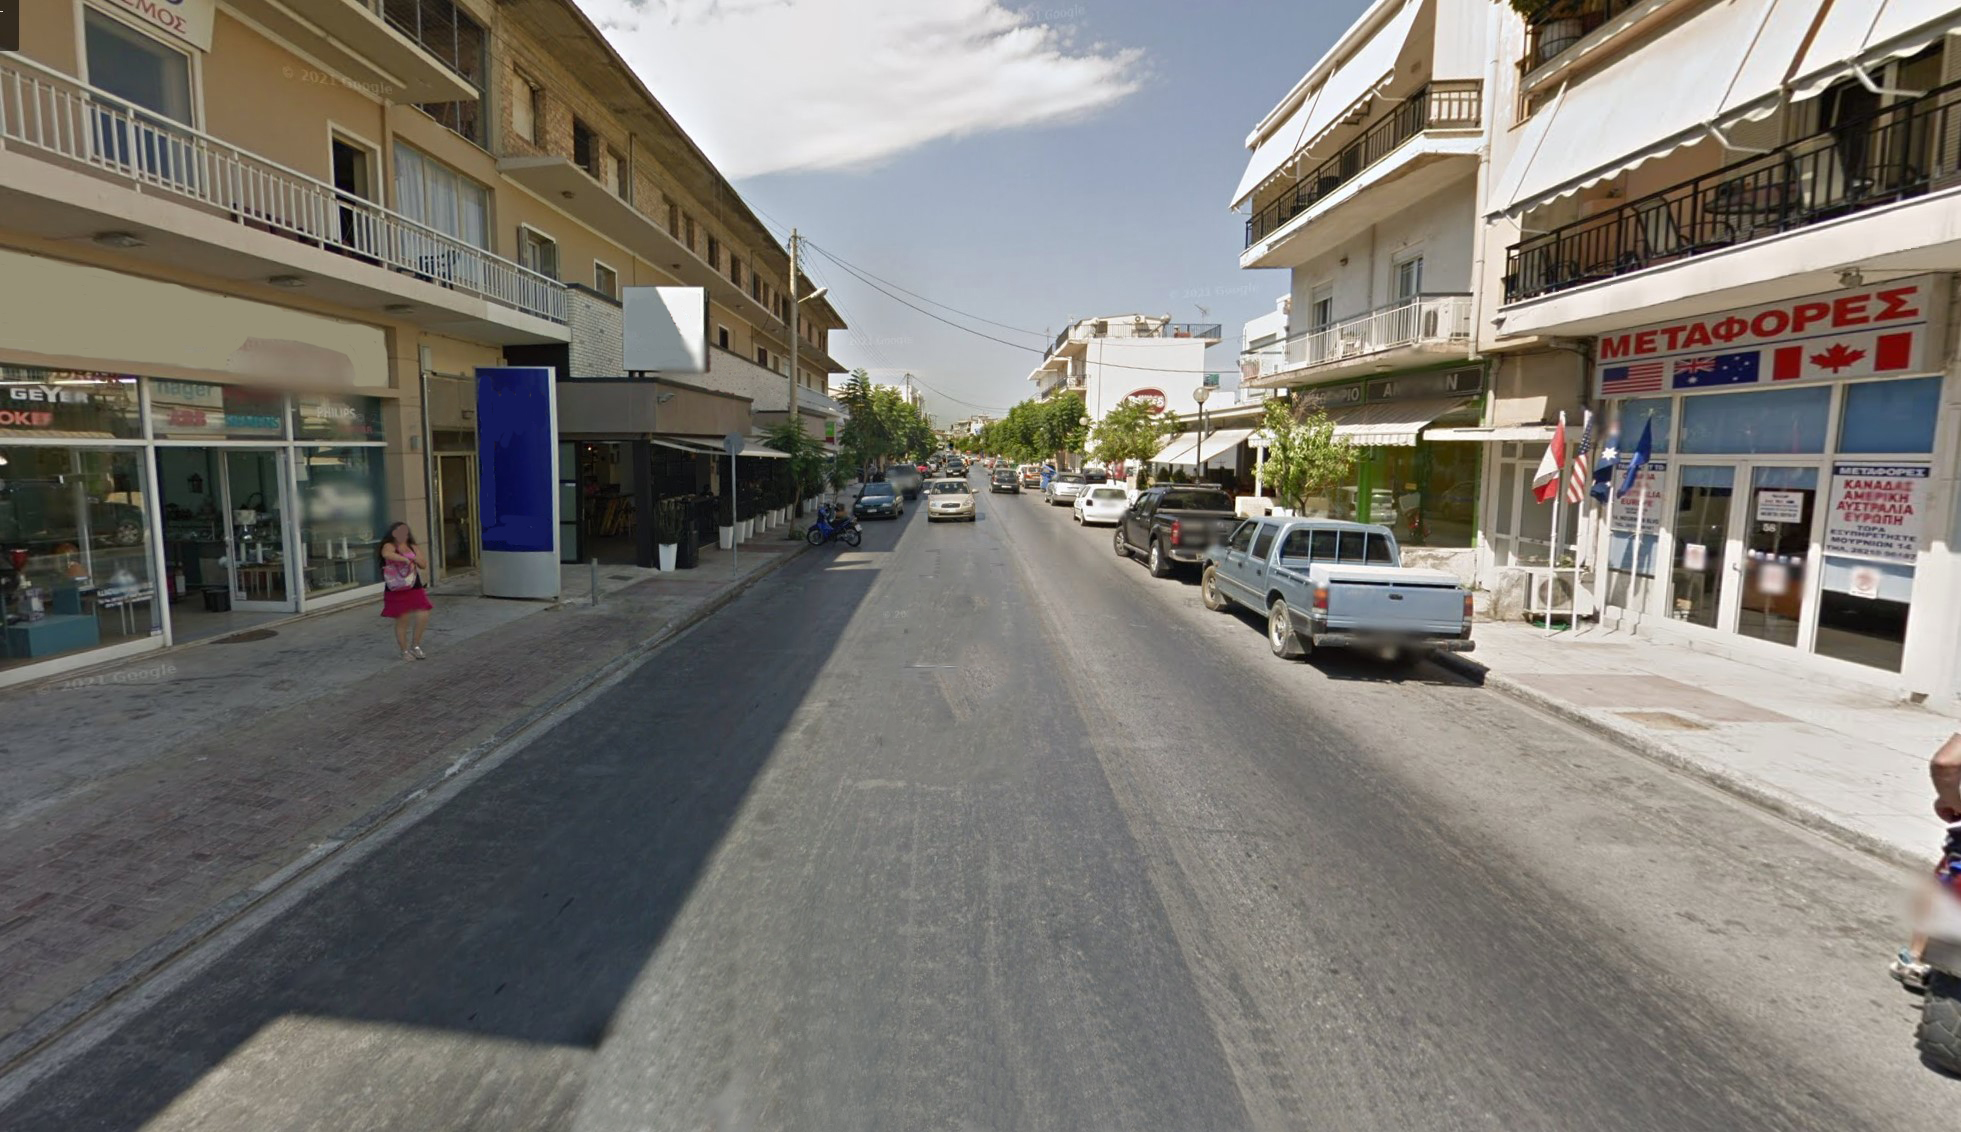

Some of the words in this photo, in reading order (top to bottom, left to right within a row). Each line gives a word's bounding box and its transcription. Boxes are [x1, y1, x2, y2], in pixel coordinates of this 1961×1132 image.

[1600, 286, 1919, 360] ΜΕΤΑΦΟΡΕΣ
[1839, 467, 1926, 477] ΜΕΤΑΦΟΡΕΣ
[1844, 490, 1910, 503] ΑΜΕΡΙΚΗ
[1836, 501, 1914, 515] ΑΥΣΤΡΑΛΙΑ
[1844, 512, 1904, 526] ΕΥΡΩΠΗ
